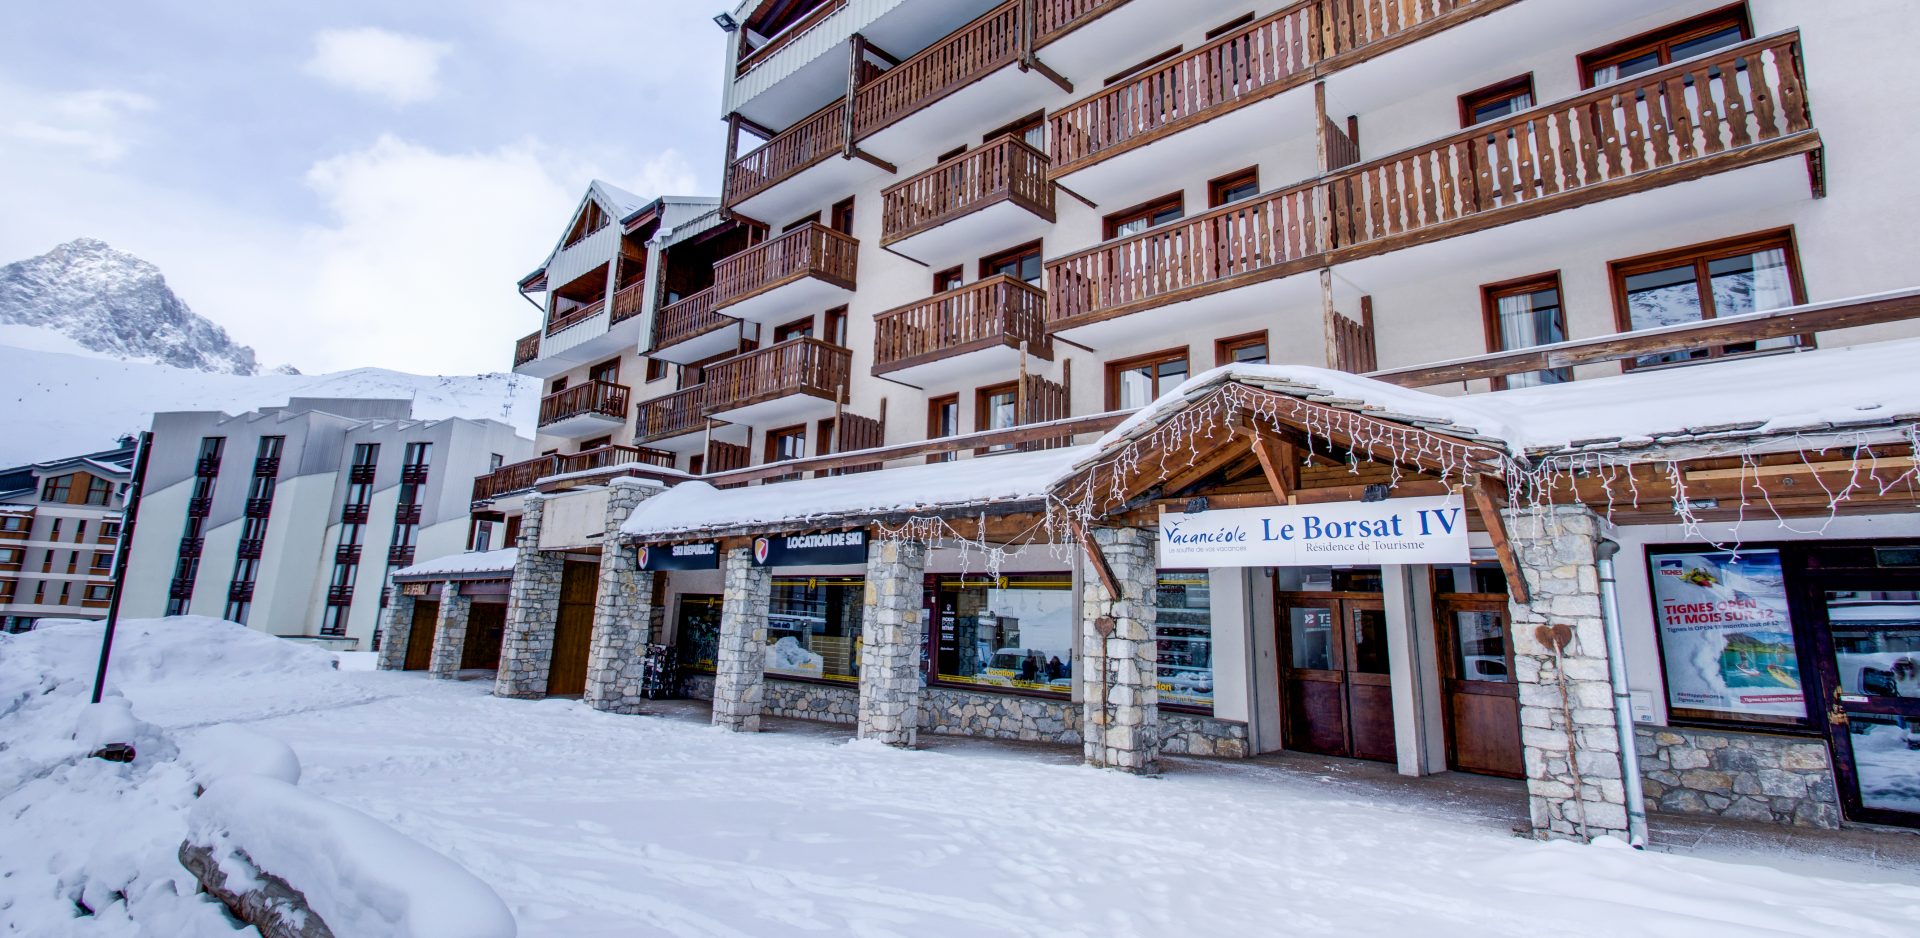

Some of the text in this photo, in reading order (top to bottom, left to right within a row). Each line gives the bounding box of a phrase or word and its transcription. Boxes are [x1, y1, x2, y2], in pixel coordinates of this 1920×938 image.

[1261, 507, 1461, 541] Le Borsat IV
[787, 532, 862, 549] LOCATION DE SKI
[1164, 525, 1247, 545] Vacancéole
[672, 544, 714, 556] SKI REPUBLIC
[1306, 540, 1425, 552] Résidence de Tourisme
[1664, 598, 1757, 615] TIGNES OPEN
[1666, 608, 1774, 625] 11 MOIS SUR 12
[1667, 626, 1687, 634] Tignes
[1723, 622, 1748, 630] months
